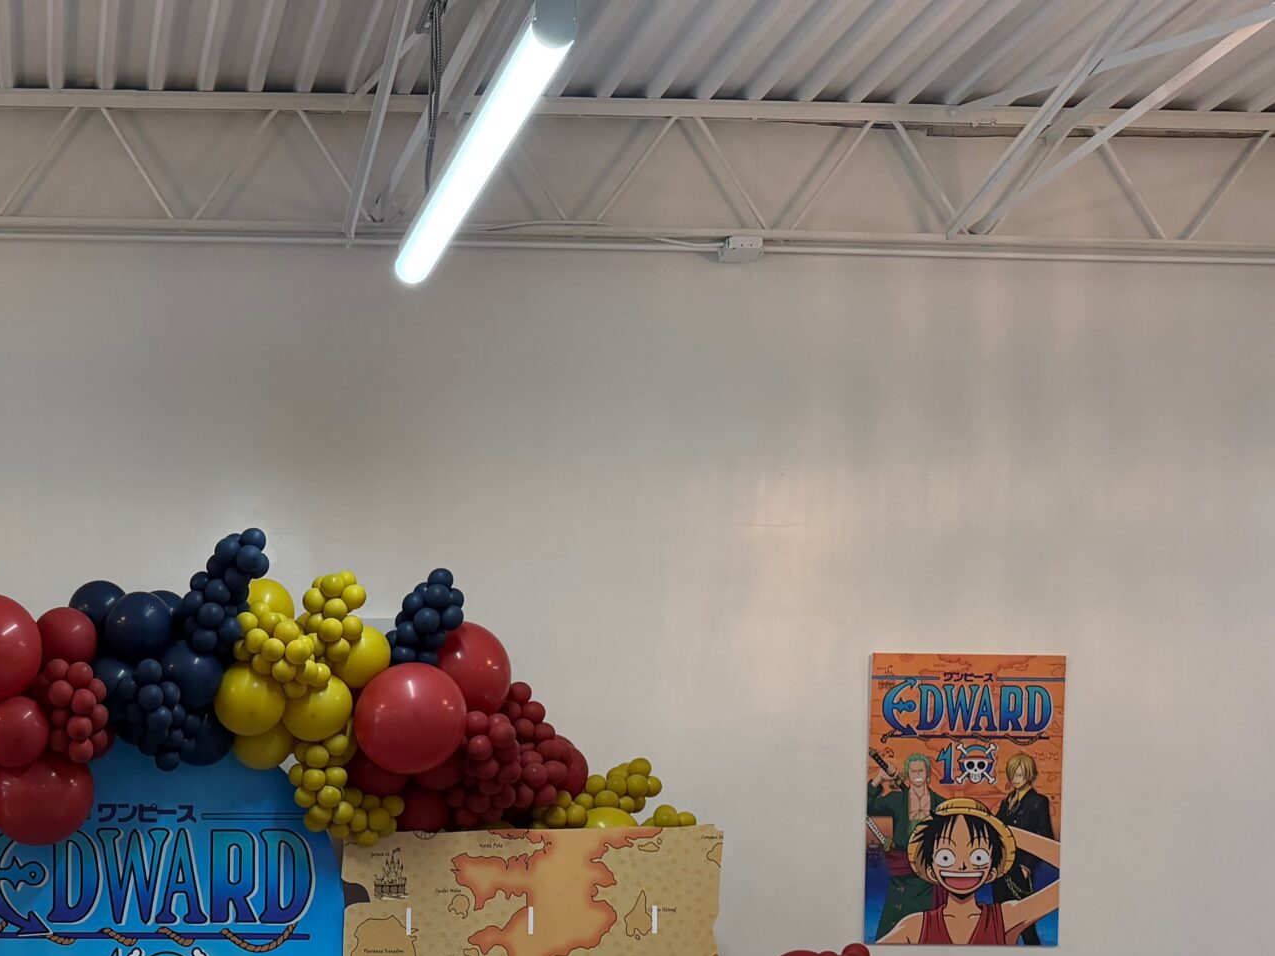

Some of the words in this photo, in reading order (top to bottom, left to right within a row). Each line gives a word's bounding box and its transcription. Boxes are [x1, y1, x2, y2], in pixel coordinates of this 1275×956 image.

[943, 672, 994, 682] ワンピース
[882, 678, 1053, 736] EDWARD
[97, 803, 197, 824] ワンピース
